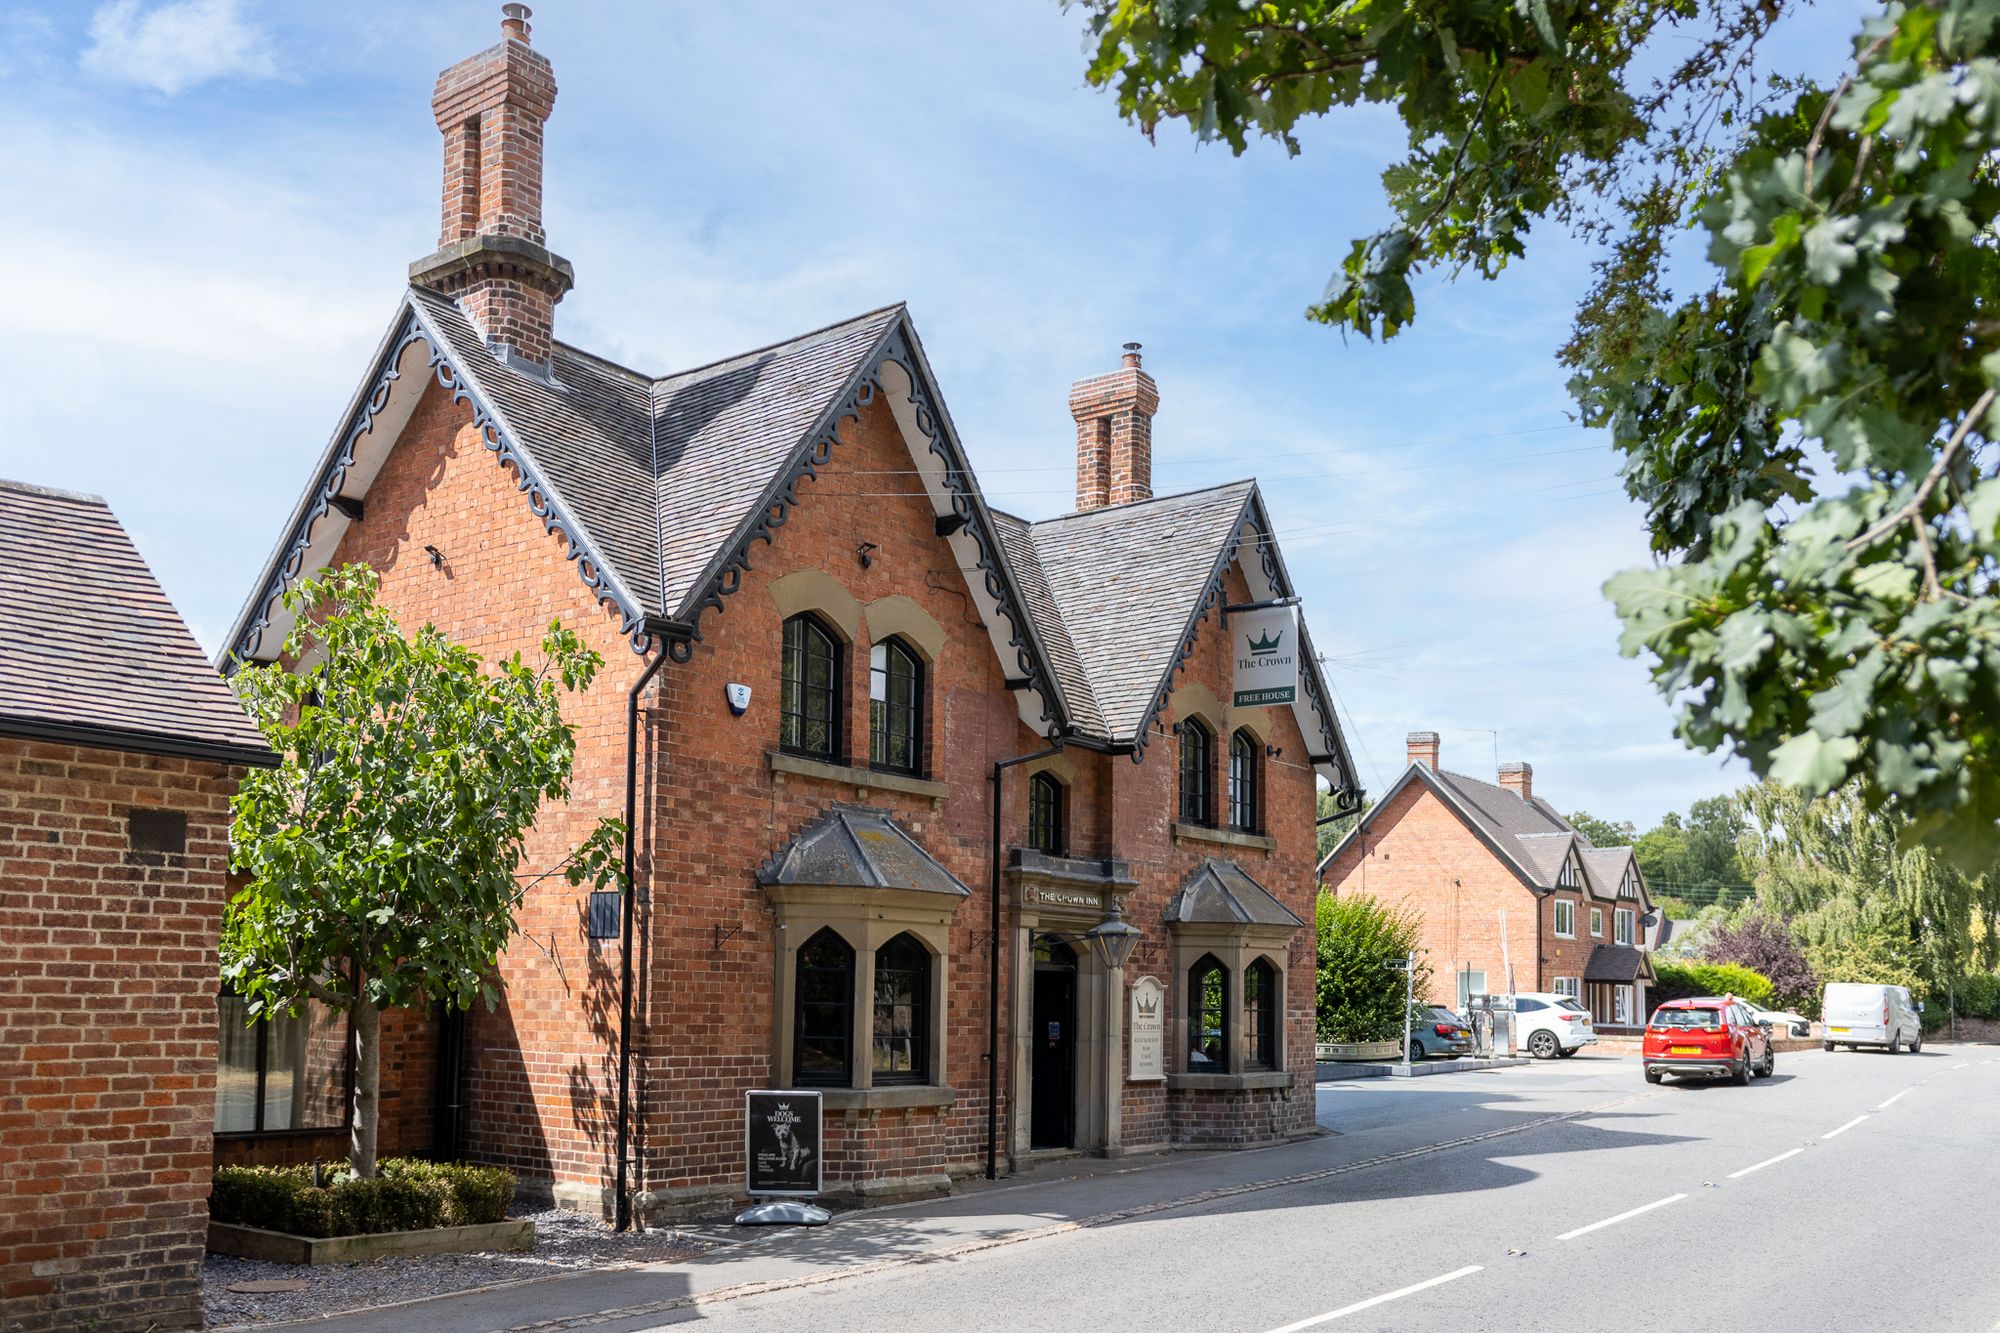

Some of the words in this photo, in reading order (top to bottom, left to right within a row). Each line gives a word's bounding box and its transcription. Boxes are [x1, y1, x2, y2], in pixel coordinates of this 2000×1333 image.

[1237, 658, 1256, 669] The
[1258, 656, 1291, 667] Crown
[1239, 693, 1260, 703] FREE
[1262, 690, 1290, 700] HOUSE
[1040, 891, 1055, 901] THE
[1086, 896, 1098, 905] INN
[1133, 1020, 1143, 1030] The
[1143, 1022, 1161, 1030] Crown
